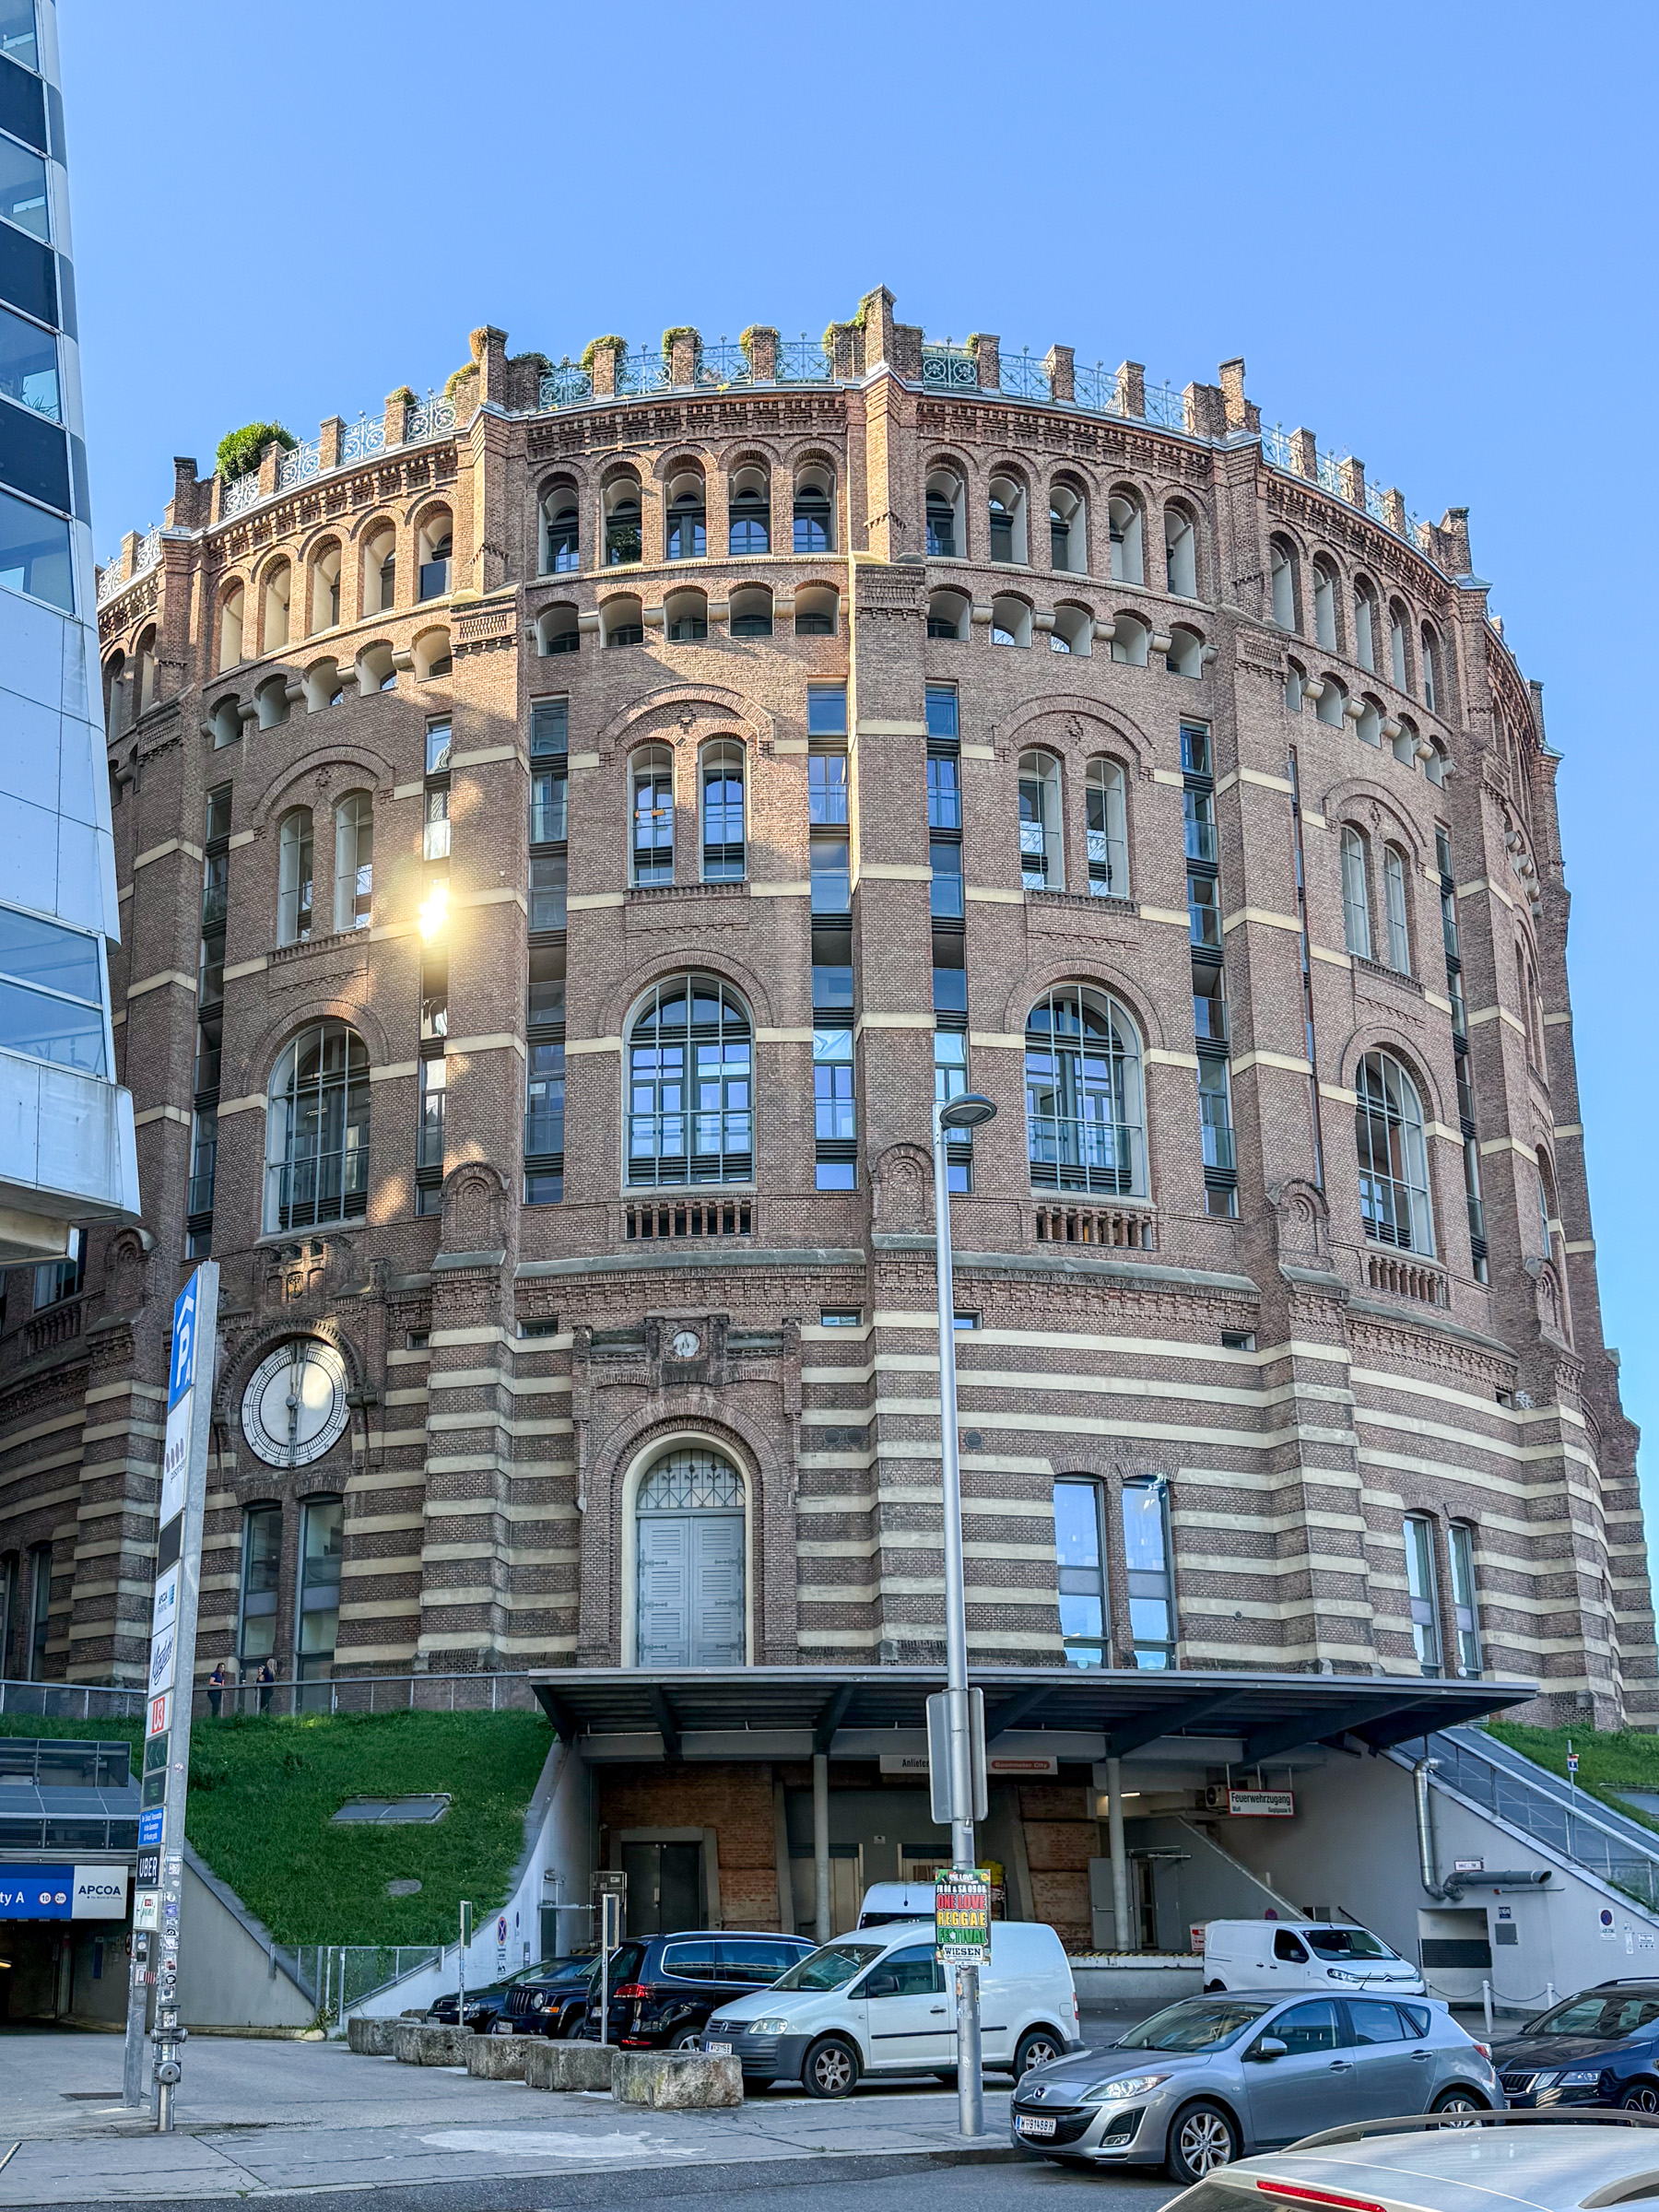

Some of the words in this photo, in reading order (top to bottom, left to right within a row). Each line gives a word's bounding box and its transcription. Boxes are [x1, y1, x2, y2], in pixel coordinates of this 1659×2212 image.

[176, 1323, 190, 1389] P
[153, 1700, 164, 1731] U3
[1231, 1793, 1290, 1806] Feuerwehrzugang
[139, 1855, 158, 1877] UBER
[78, 1885, 121, 1895] APCOA
[959, 1885, 966, 1893] SA
[16, 1891, 24, 1903] A
[936, 1894, 956, 1910] ONE
[957, 1894, 986, 1910] LOVE
[936, 1911, 986, 1926] REGGAE
[944, 1947, 981, 1956] WIESEN
